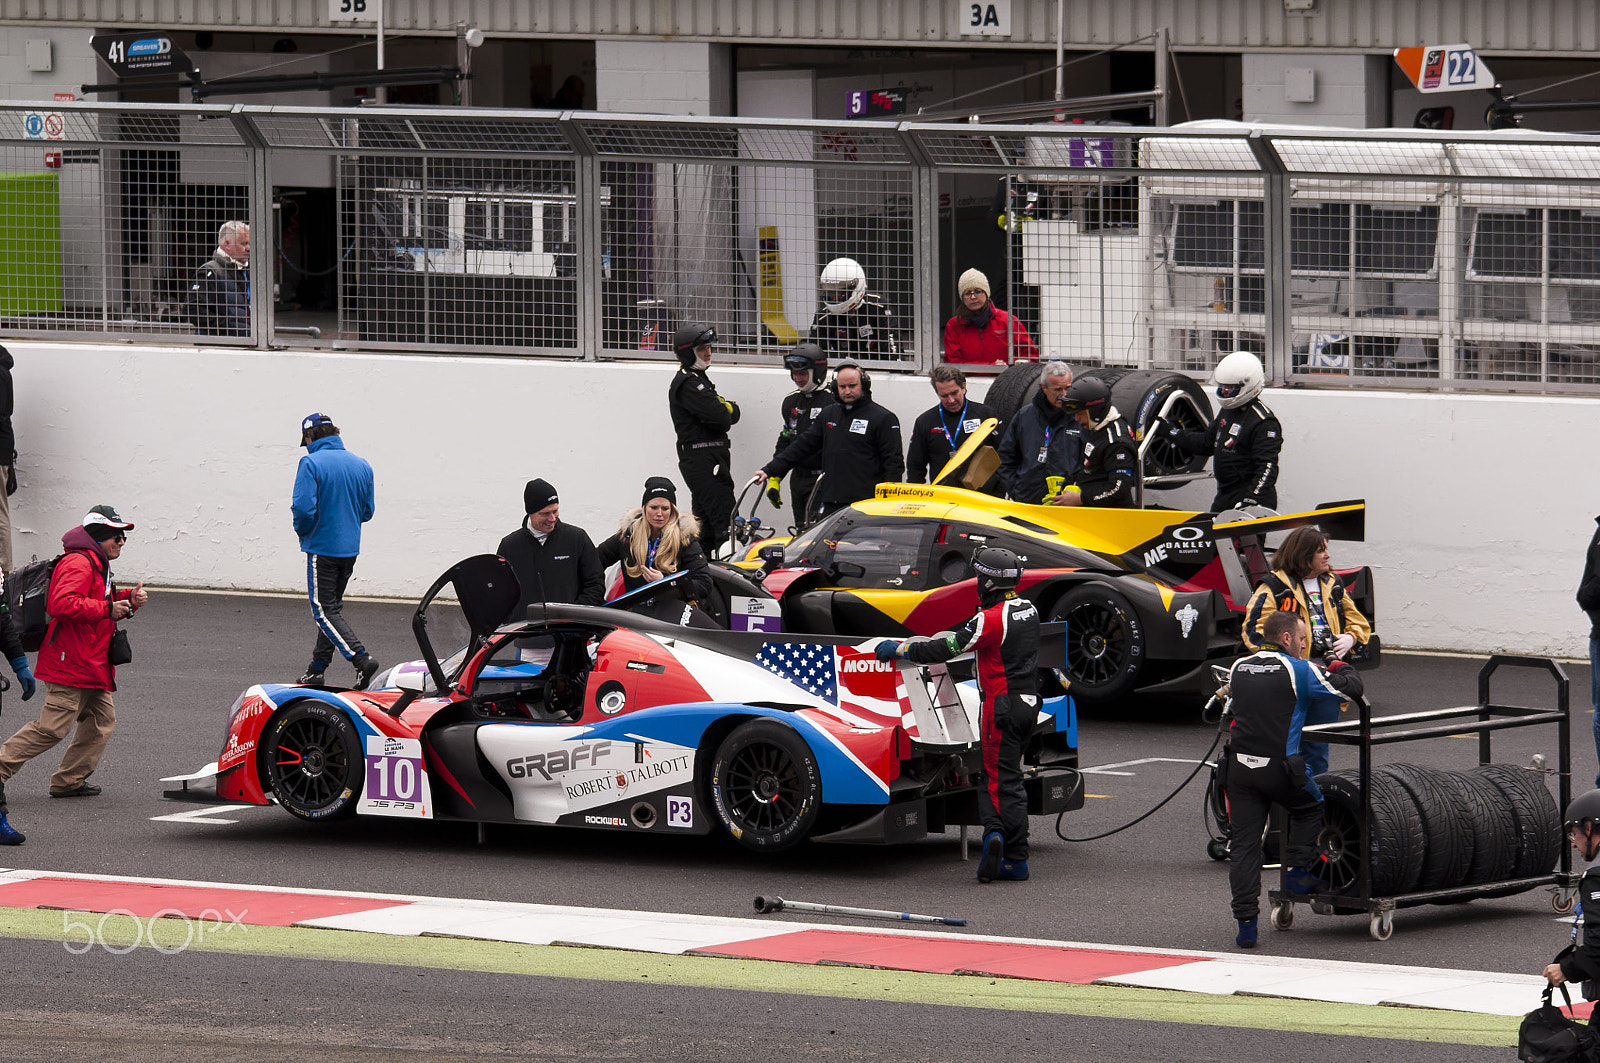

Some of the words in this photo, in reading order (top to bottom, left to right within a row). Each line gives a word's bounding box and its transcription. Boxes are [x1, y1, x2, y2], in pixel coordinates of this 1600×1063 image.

[970, 4, 999, 26] 3A
[108, 41, 124, 63] 41
[1449, 51, 1475, 83] 22
[851, 92, 861, 113] 5
[1166, 541, 1212, 549] OAKLEY
[844, 660, 893, 673] MOTUL
[506, 741, 612, 780] GRAFF
[374, 757, 415, 799] 10
[566, 775, 612, 800] ROBERT
[627, 755, 689, 783] TALBOTT
[585, 815, 628, 826] ROCKWELL
[669, 800, 691, 823] P3
